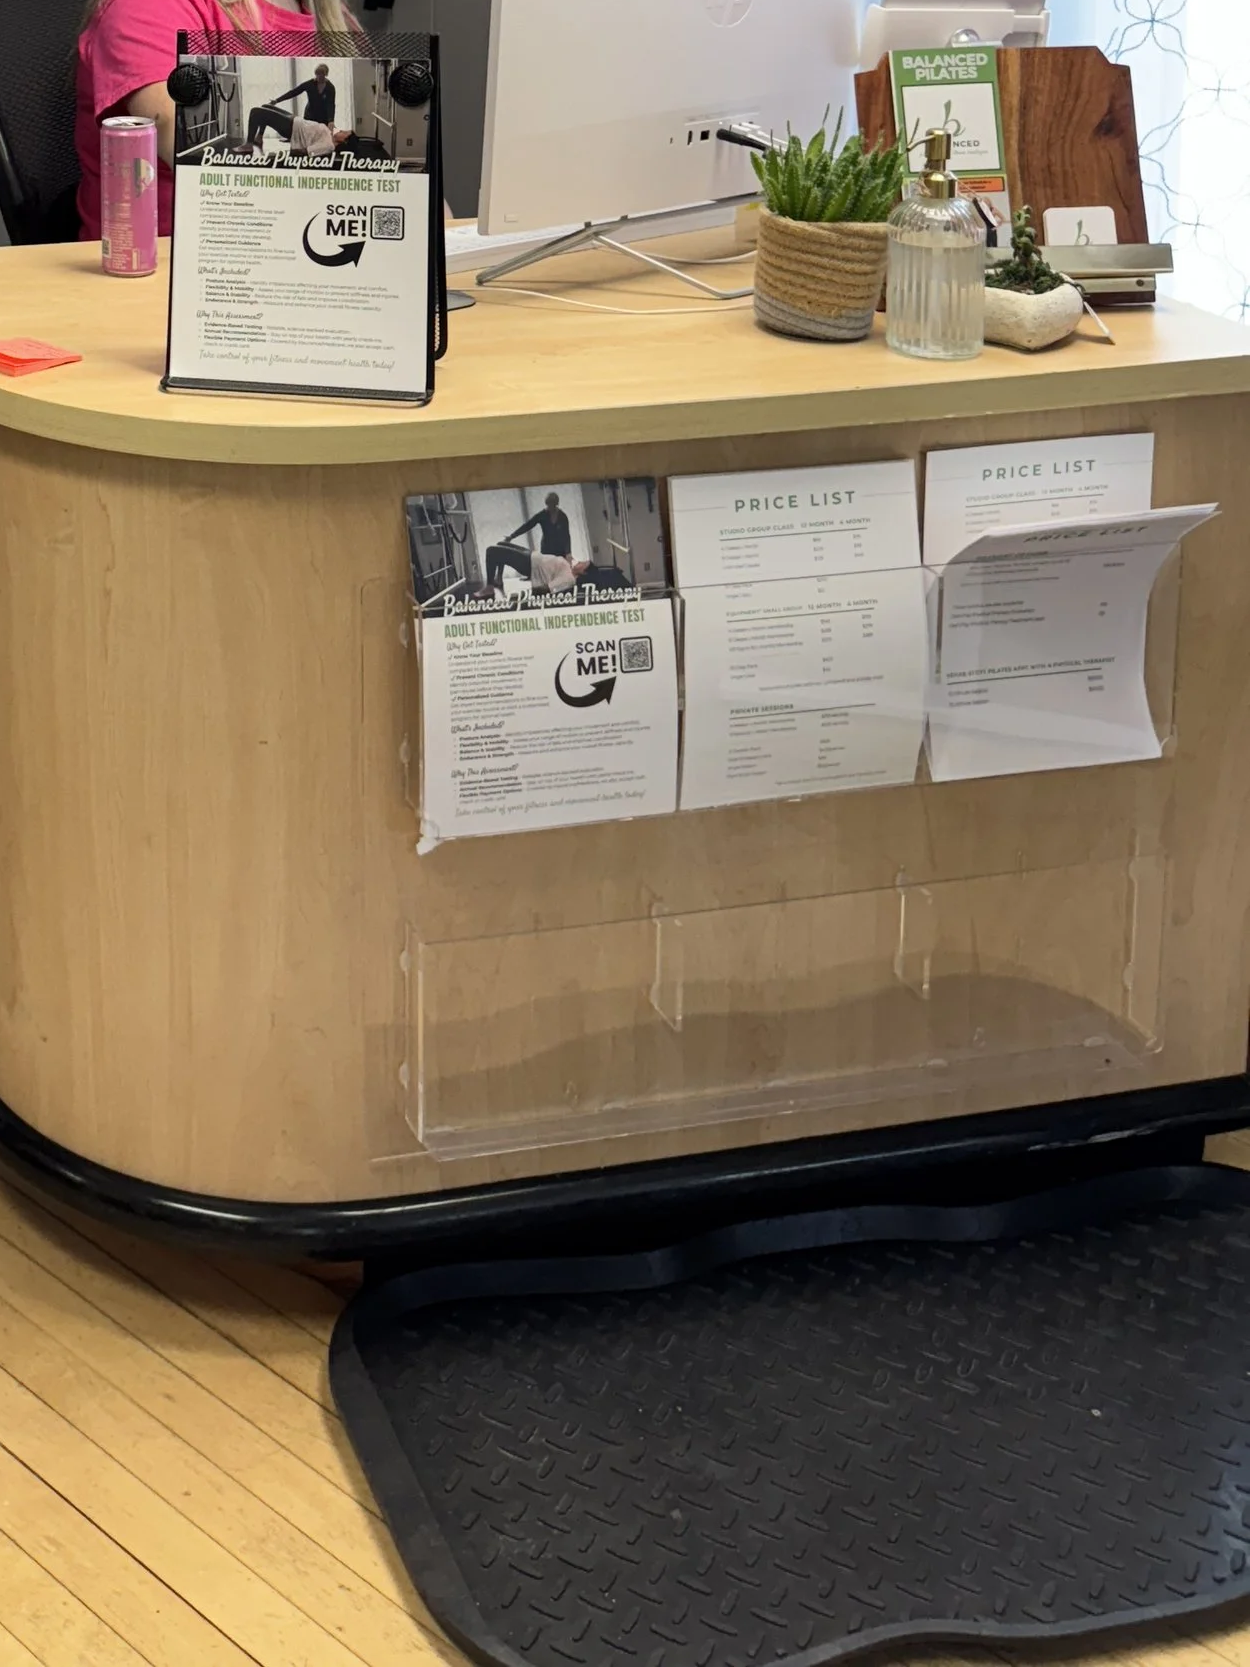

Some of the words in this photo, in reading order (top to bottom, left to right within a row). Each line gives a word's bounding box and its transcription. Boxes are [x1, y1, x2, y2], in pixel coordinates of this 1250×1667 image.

[902, 53, 988, 69] BALANCED
[915, 66, 978, 81] PILATES
[952, 140, 980, 148] NCED
[201, 146, 271, 166] Balanced
[271, 150, 336, 174] Physical
[340, 150, 400, 177] Therapy
[199, 173, 230, 186] ADULT
[234, 174, 295, 189] FUNCTIONAL
[298, 176, 373, 191] INDEPENDENCE
[377, 179, 401, 193] TEST
[326, 204, 367, 216] SCAN
[326, 218, 367, 237] ME!
[982, 464, 1042, 481] PRICE
[1053, 459, 1096, 474] LIST
[734, 495, 798, 512] PRICE
[810, 491, 856, 507] LIST
[443, 594, 513, 617] Balanced
[517, 585, 578, 611] Physical
[581, 583, 642, 608] Therapy
[444, 622, 476, 638] ADULT
[480, 617, 540, 635] FUNCTIONAL
[544, 610, 619, 630] INDEPENDENCE
[622, 608, 645, 623] TEST
[575, 640, 615, 654] SCAN
[576, 654, 617, 676] ME!
